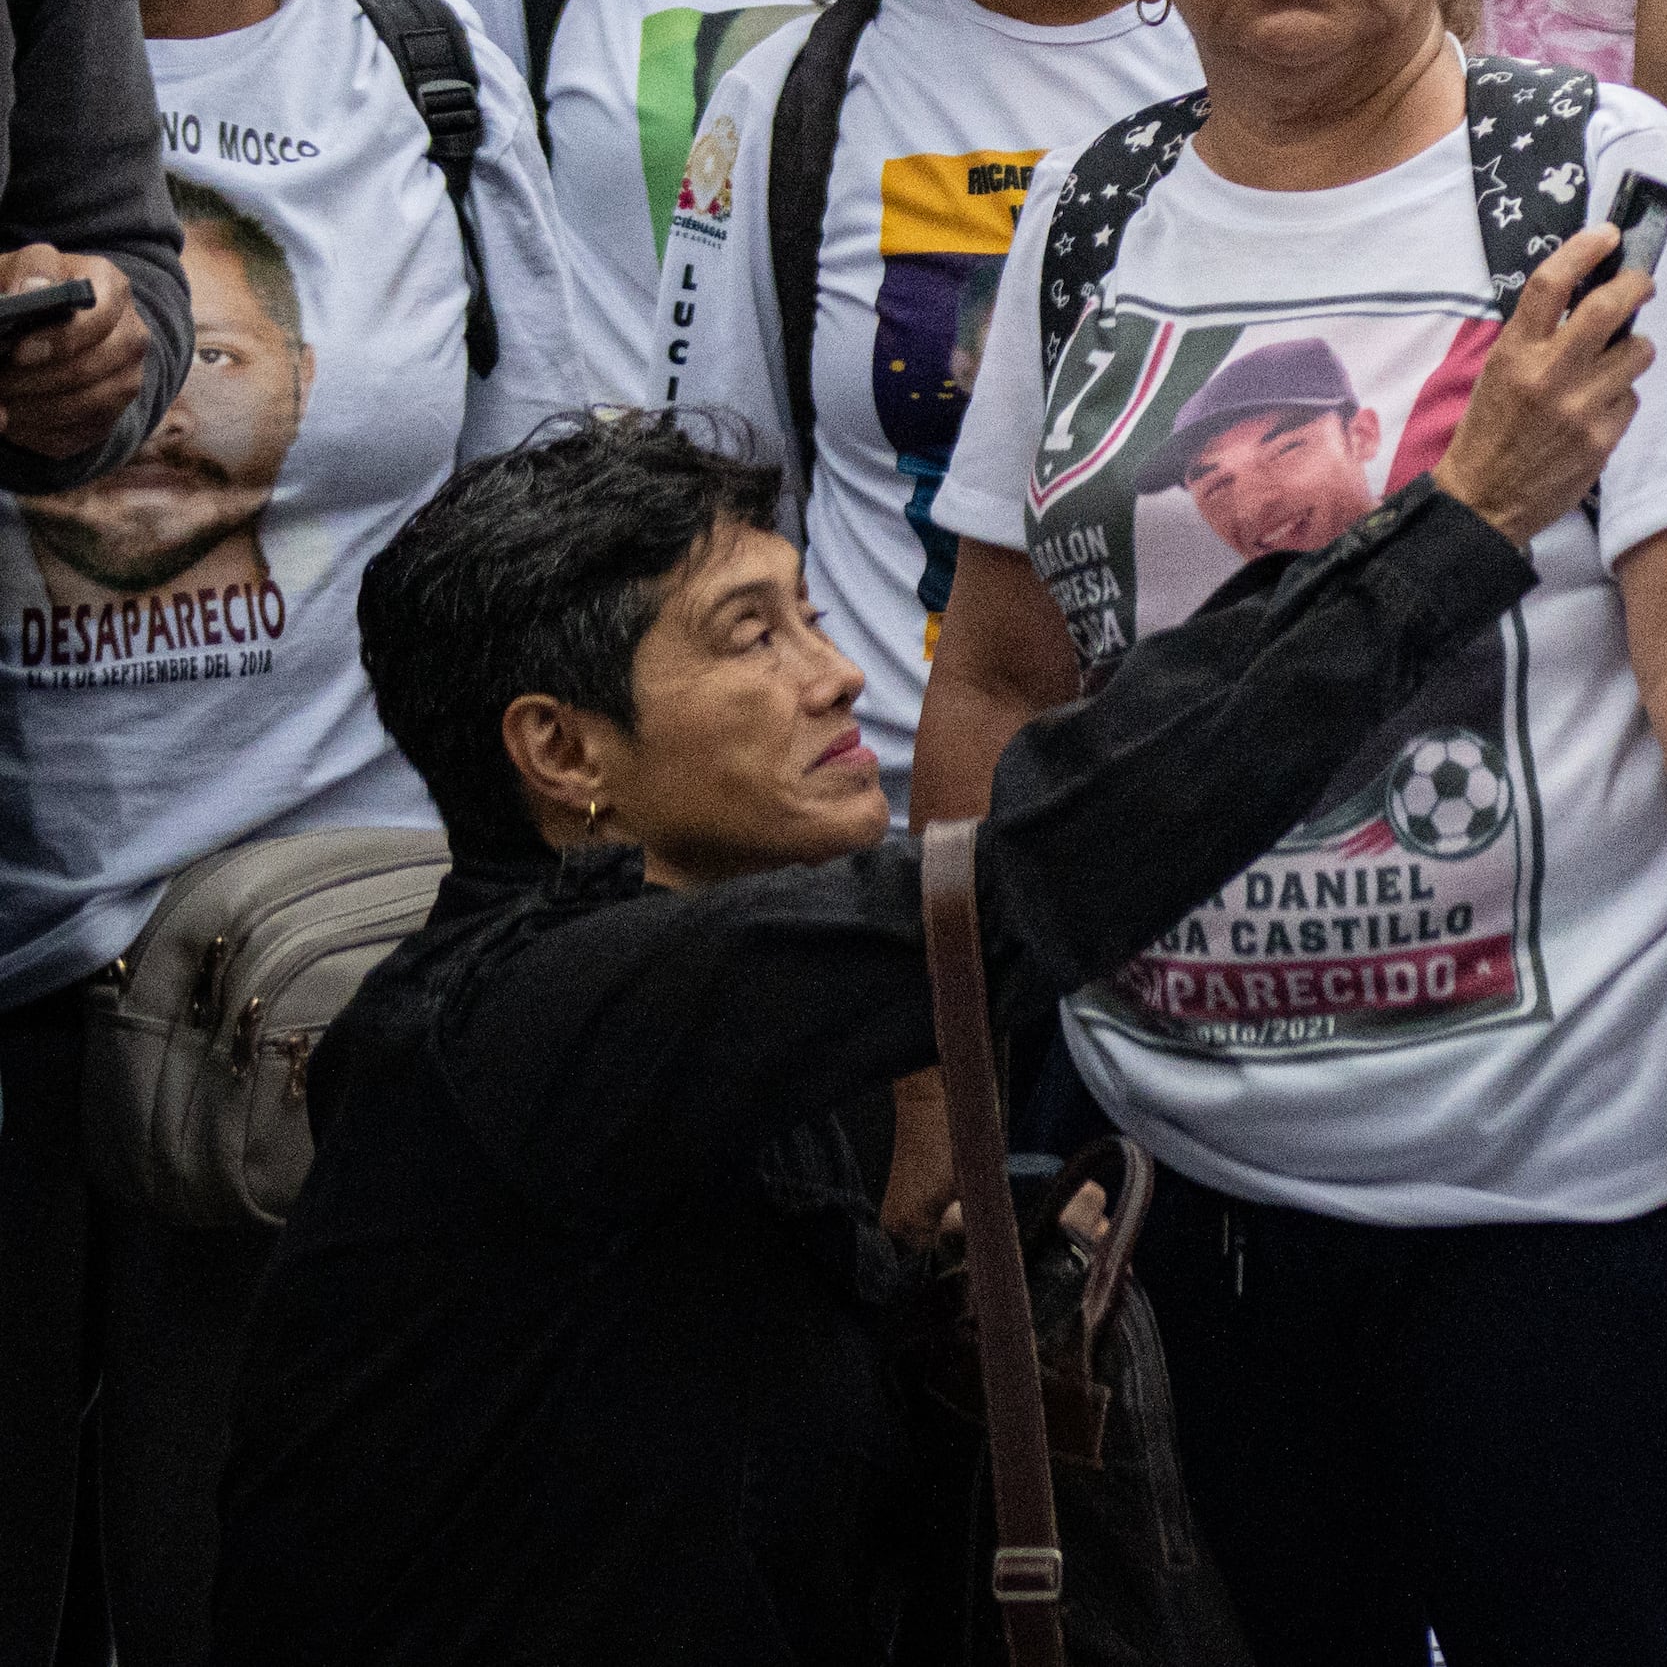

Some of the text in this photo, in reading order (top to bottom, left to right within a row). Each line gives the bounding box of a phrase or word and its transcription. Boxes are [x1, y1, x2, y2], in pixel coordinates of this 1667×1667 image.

[103, 655, 199, 687] SEPTIEMBRE
[203, 655, 231, 681] DEL
[1246, 862, 1434, 910] DANIEL
[1231, 902, 1473, 956] CASTILLO
[1122, 953, 1457, 1016] APARECIDO
